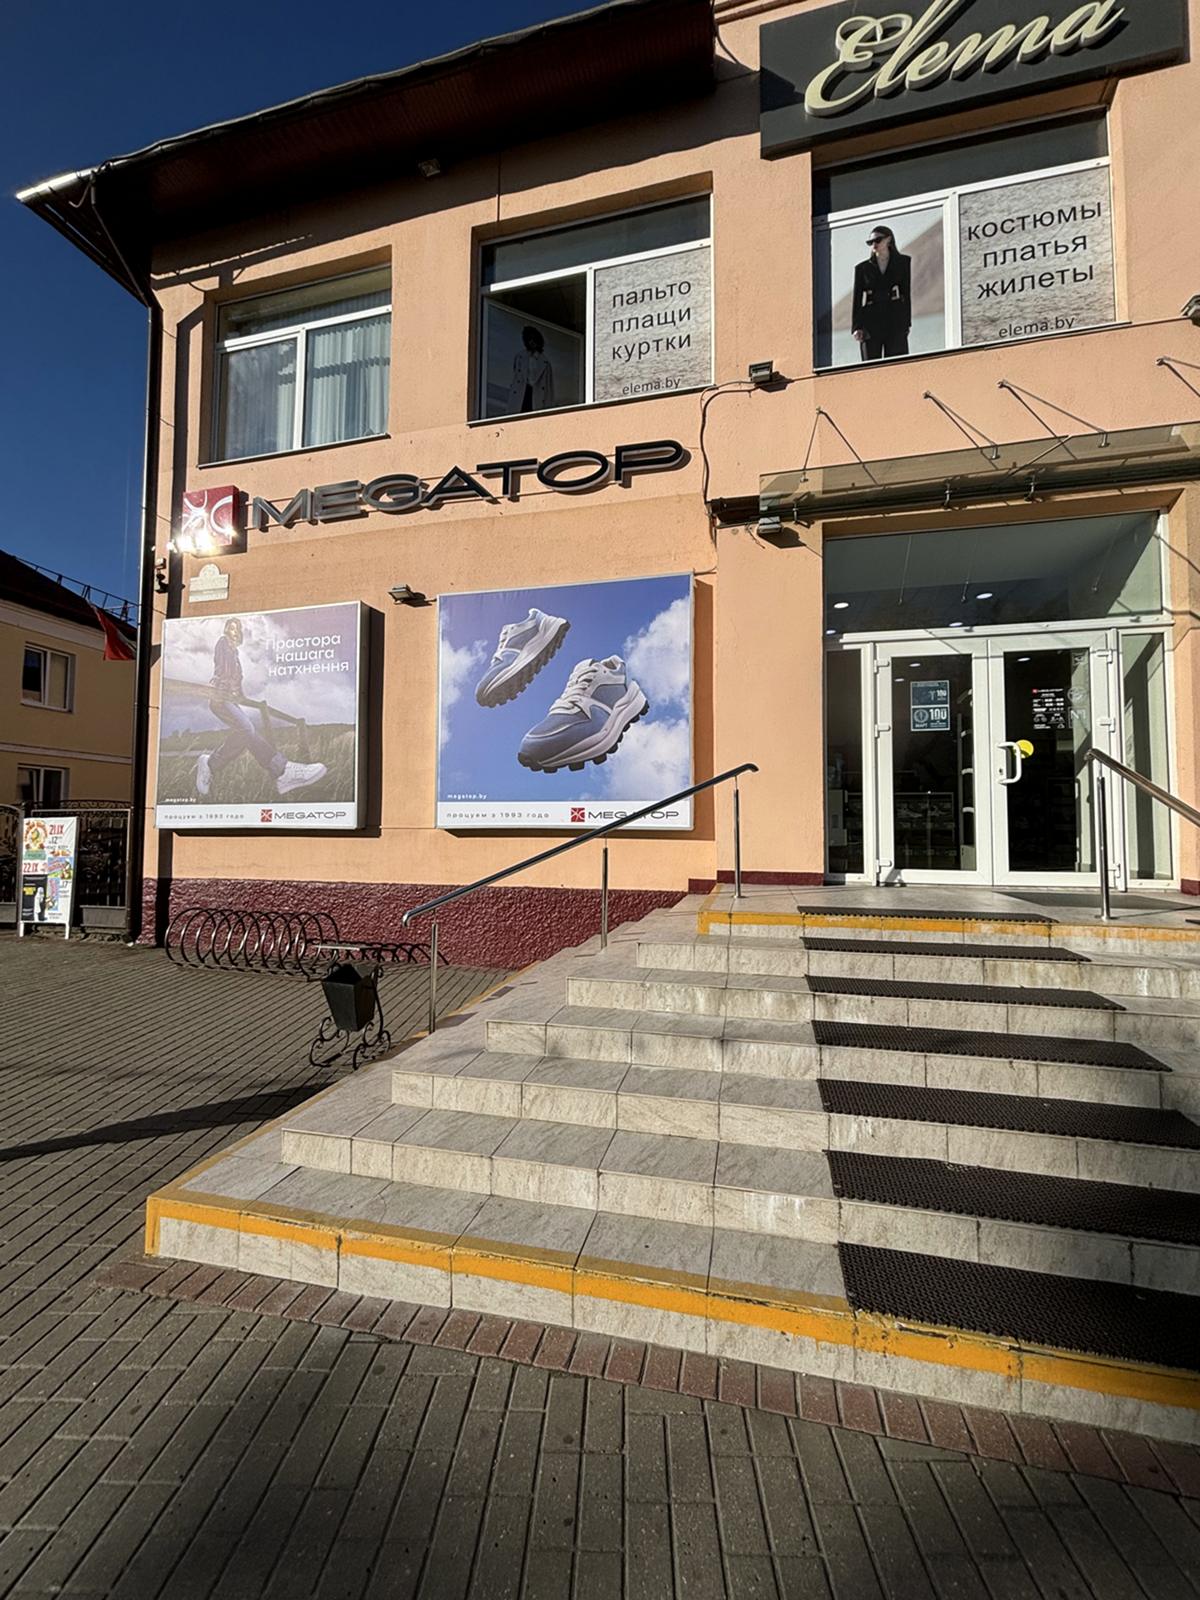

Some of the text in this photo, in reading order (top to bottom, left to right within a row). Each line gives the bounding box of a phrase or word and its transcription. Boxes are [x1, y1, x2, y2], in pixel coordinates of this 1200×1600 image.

[804, 0, 1125, 117] Elema
[967, 202, 1102, 241] костюмы
[983, 233, 1088, 269] платья
[612, 280, 692, 308] пальто
[976, 264, 1095, 300] жилеты
[611, 306, 692, 334] плащи
[998, 314, 1076, 339] elema.by
[611, 334, 692, 362] куртки
[621, 376, 682, 396] elema.by
[252, 439, 687, 529] MEGATOP
[264, 634, 341, 651] Прастора
[275, 649, 335, 663] нашага
[268, 661, 350, 677] натхнення
[273, 811, 347, 820] MEGATOP
[588, 811, 680, 819] MEGOP
